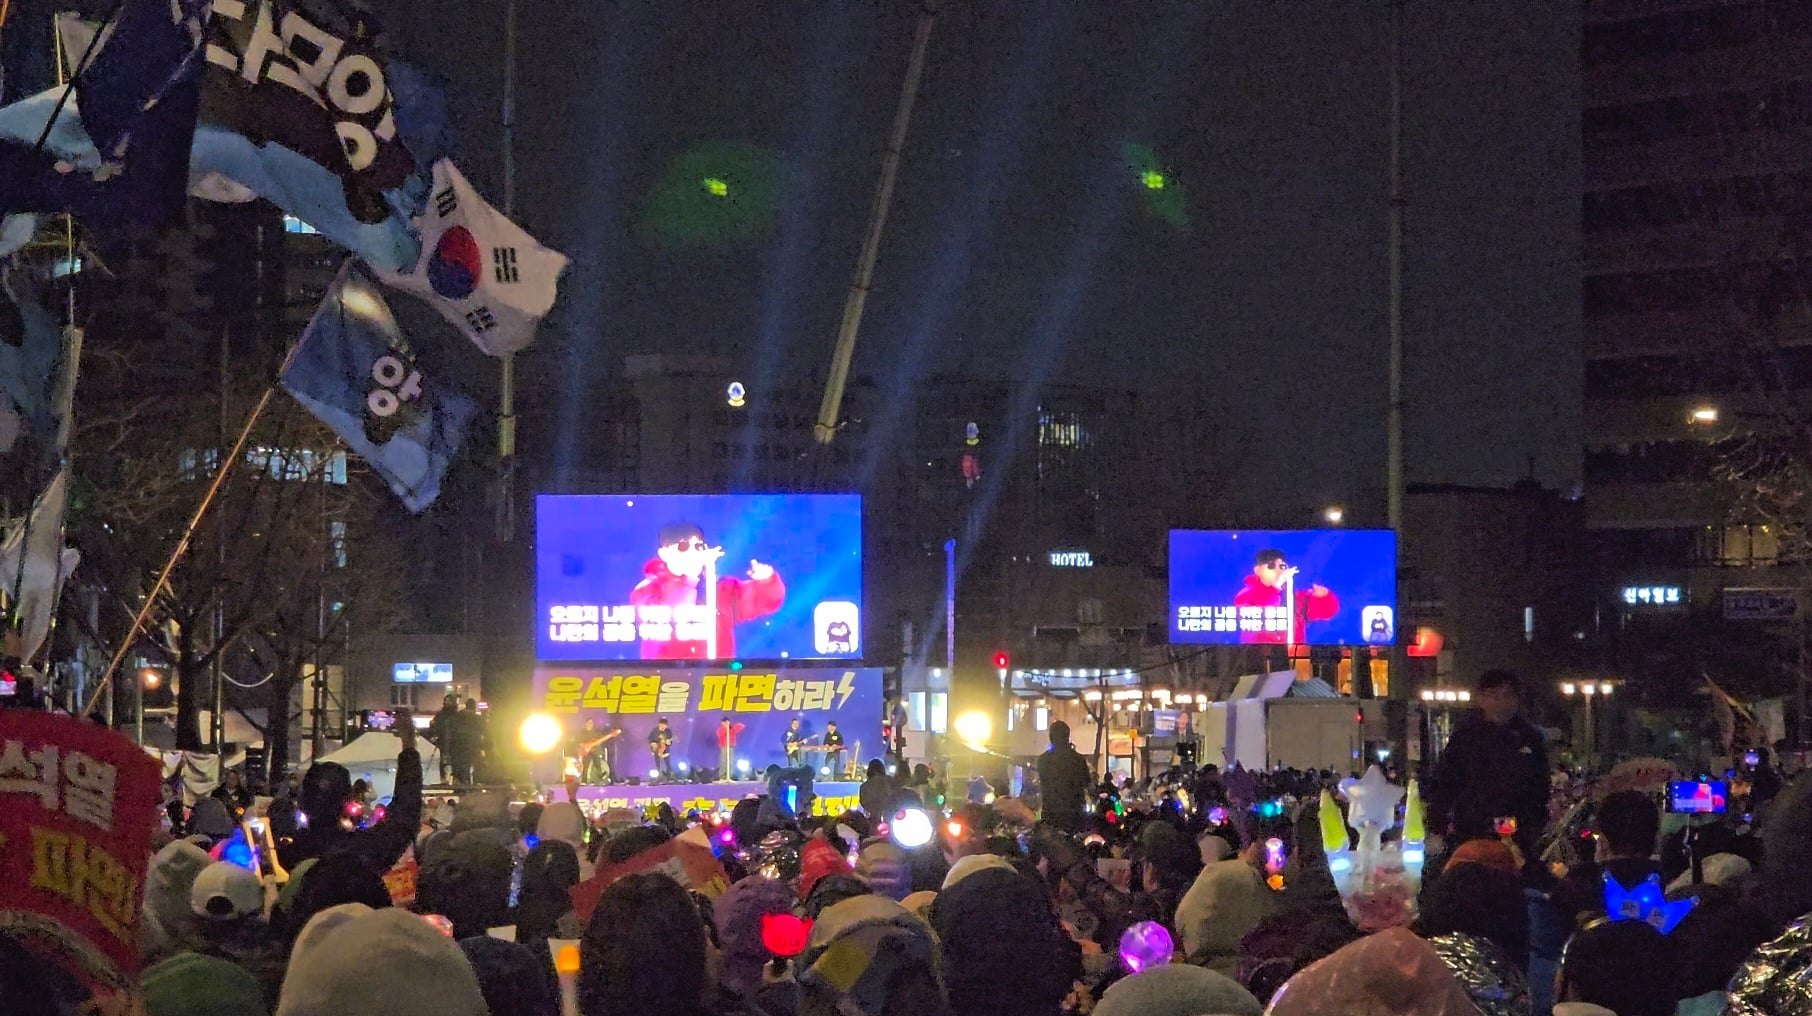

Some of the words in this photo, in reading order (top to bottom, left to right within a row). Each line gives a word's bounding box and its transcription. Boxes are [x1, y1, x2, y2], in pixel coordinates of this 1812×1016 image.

[1051, 552, 1093, 567] HOTEL
[545, 675, 690, 714] 윤석열을
[698, 673, 835, 712] 파면하라
